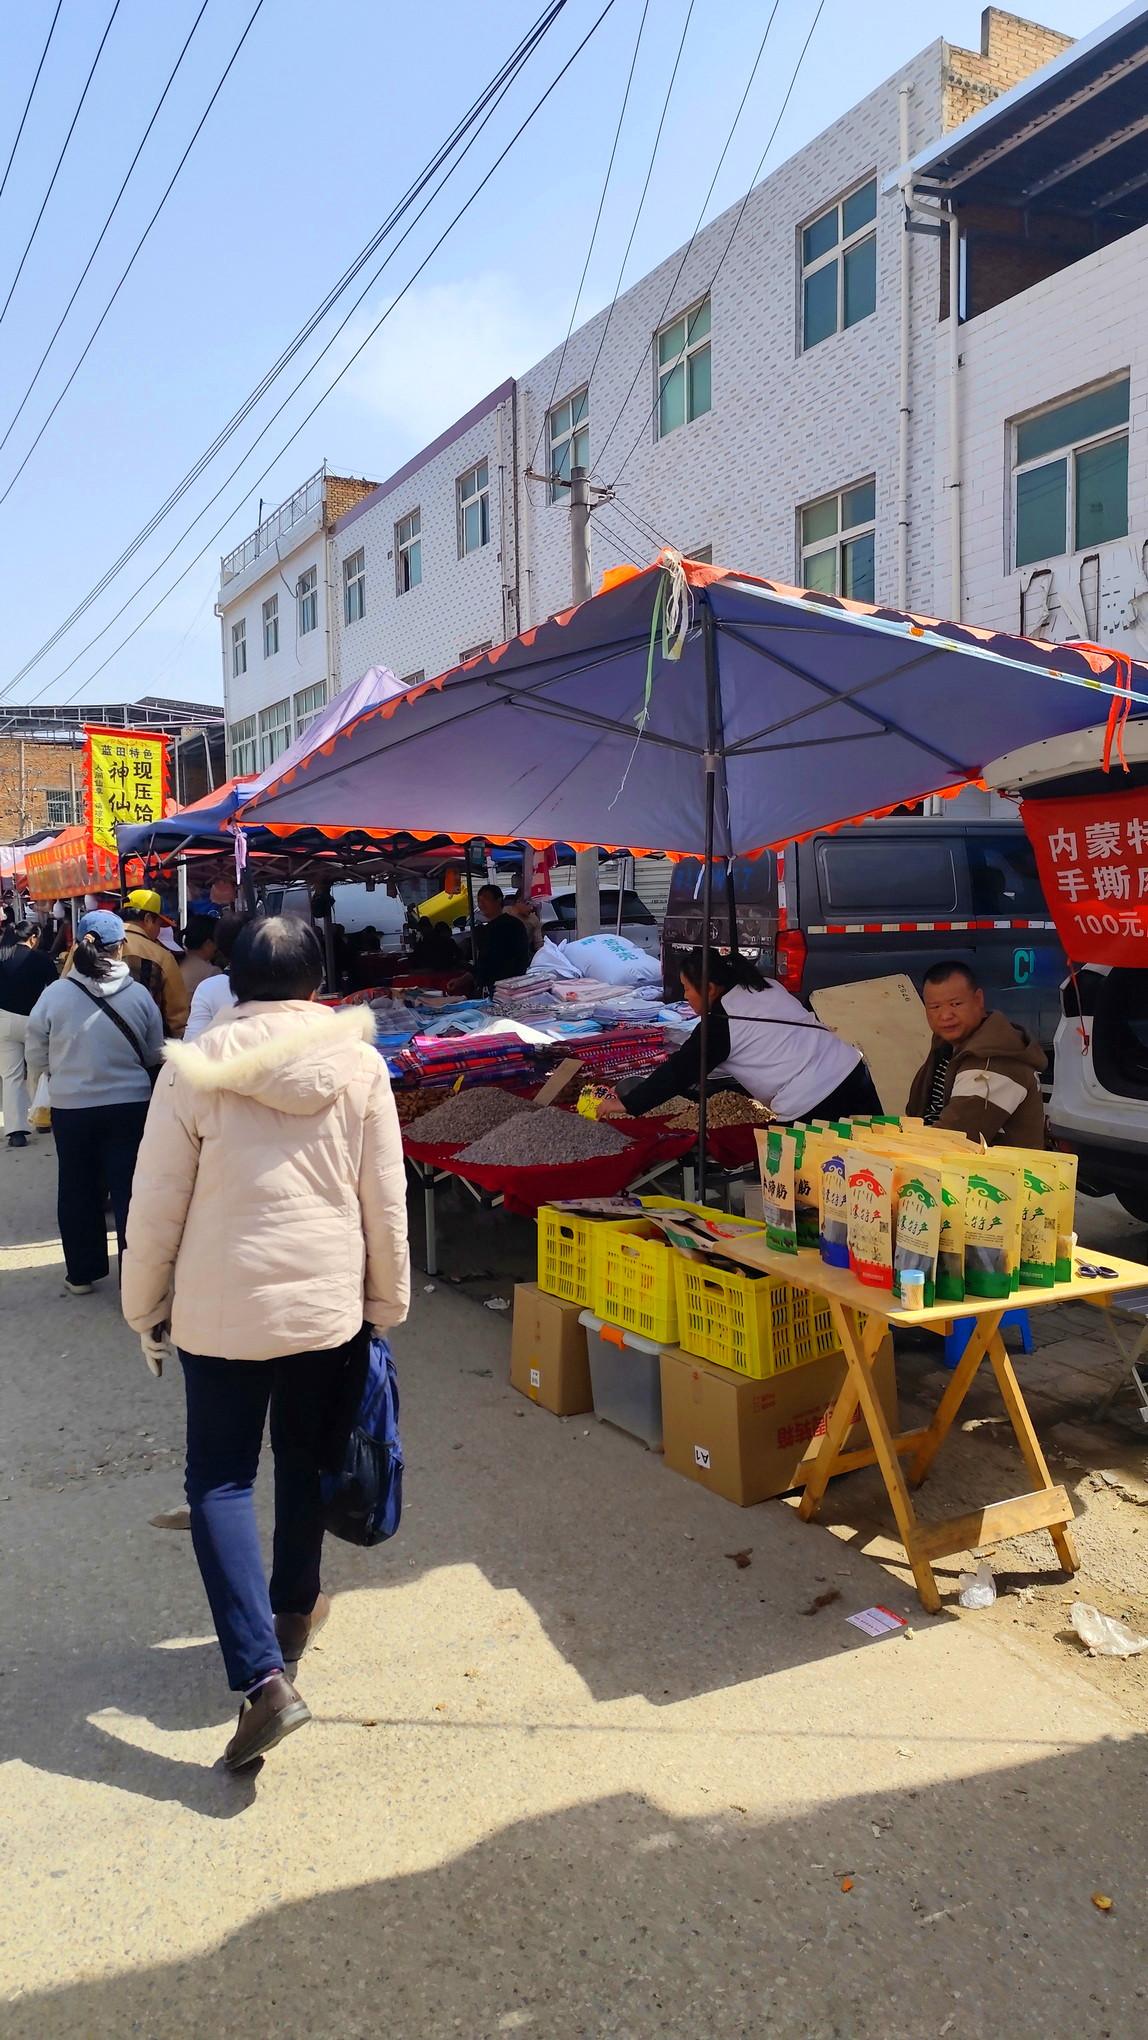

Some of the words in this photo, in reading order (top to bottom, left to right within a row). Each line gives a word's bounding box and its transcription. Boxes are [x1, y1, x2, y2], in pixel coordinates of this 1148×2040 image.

[102, 745, 153, 760] 蓝田特色
[1074, 911, 1148, 938] 100元
[850, 1204, 881, 1223] 蒙特产
[897, 1215, 928, 1236] 蒙特产
